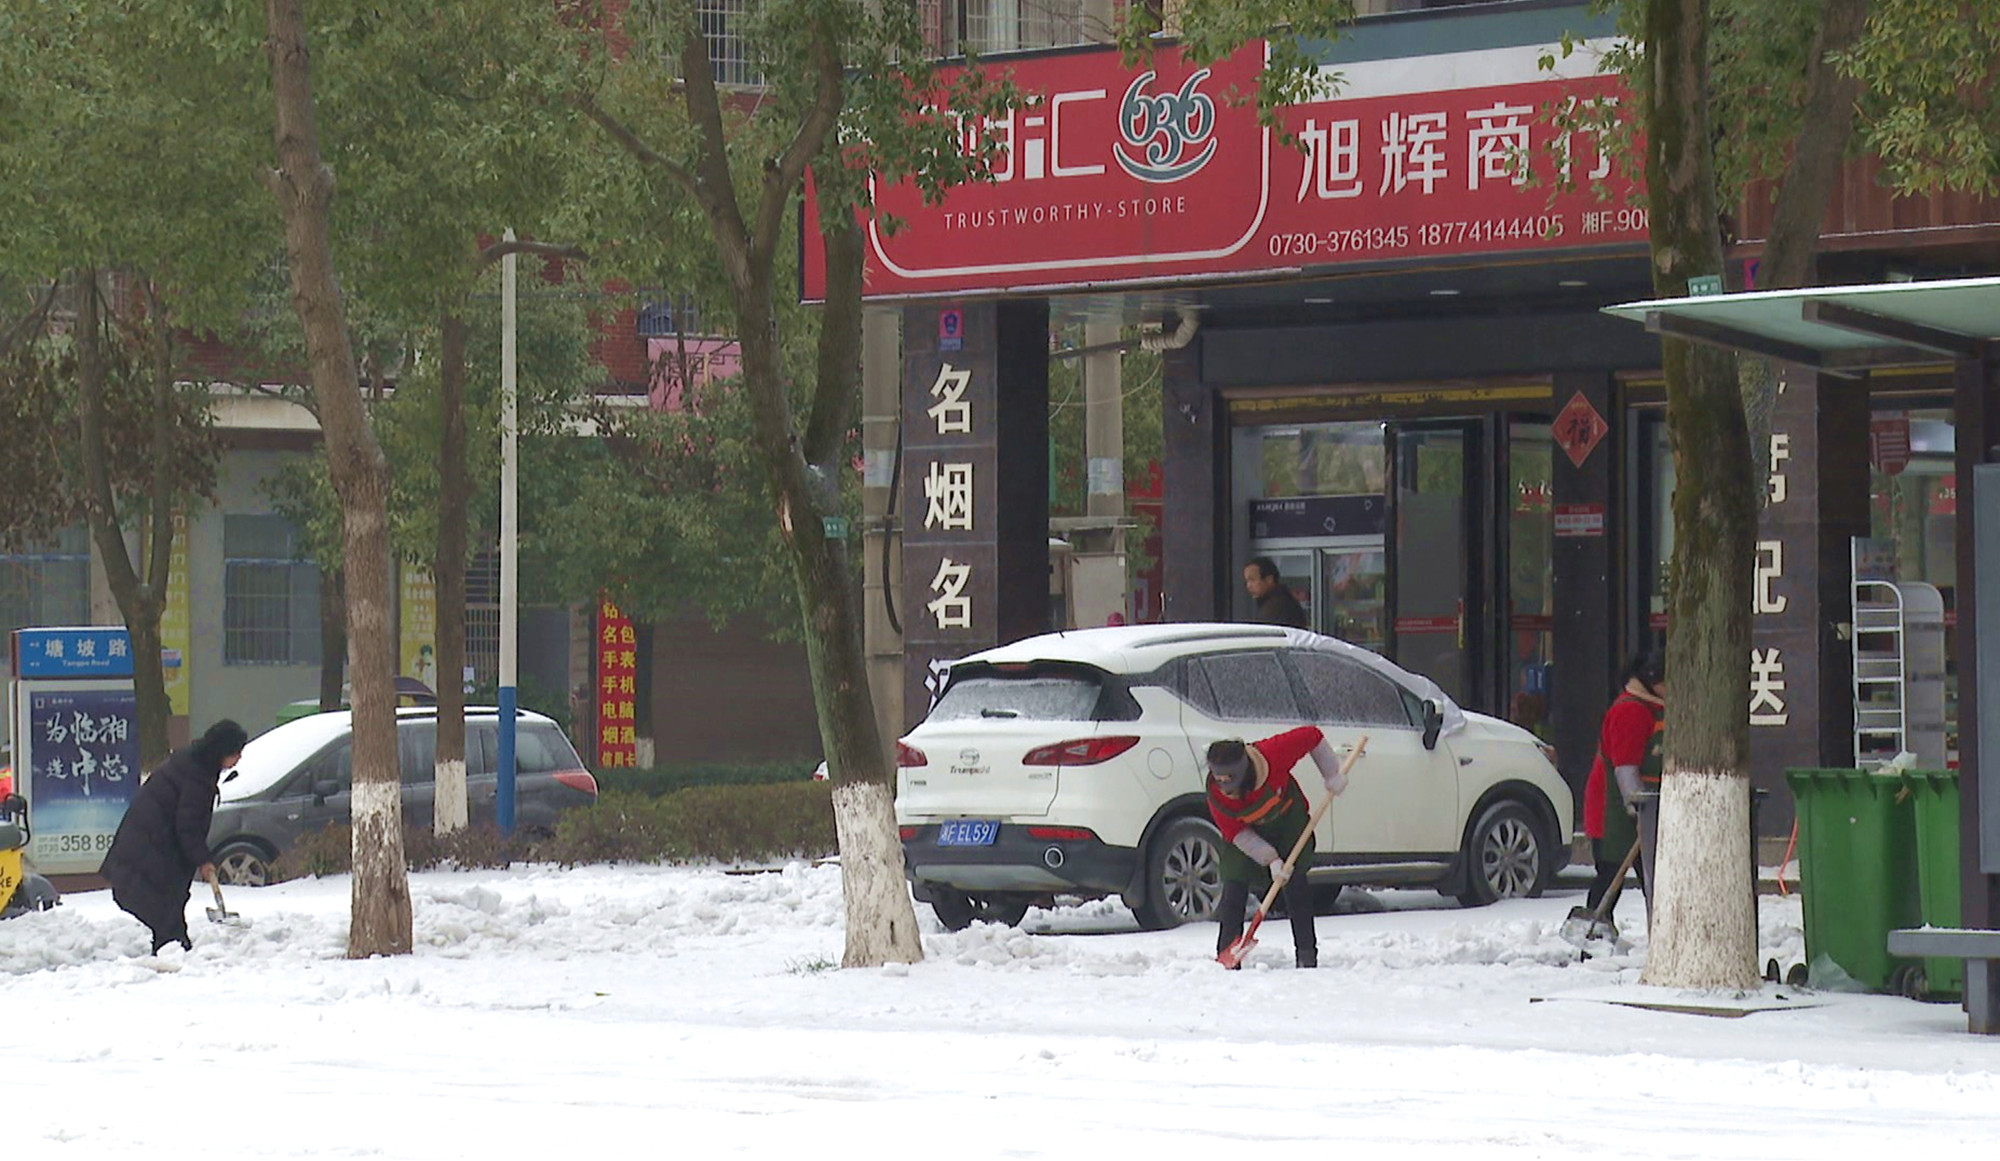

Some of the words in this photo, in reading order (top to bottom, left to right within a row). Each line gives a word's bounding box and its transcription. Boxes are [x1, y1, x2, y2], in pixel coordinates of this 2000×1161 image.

[1298, 96, 1622, 203] 旭辉商行
[944, 196, 1185, 230] TRUSTWORTHY-STORE
[1268, 225, 1409, 256] 0730-3761345
[1418, 213, 1564, 246] 18774144405
[45, 638, 127, 658] 塘坡路
[60, 834, 91, 852] 358
